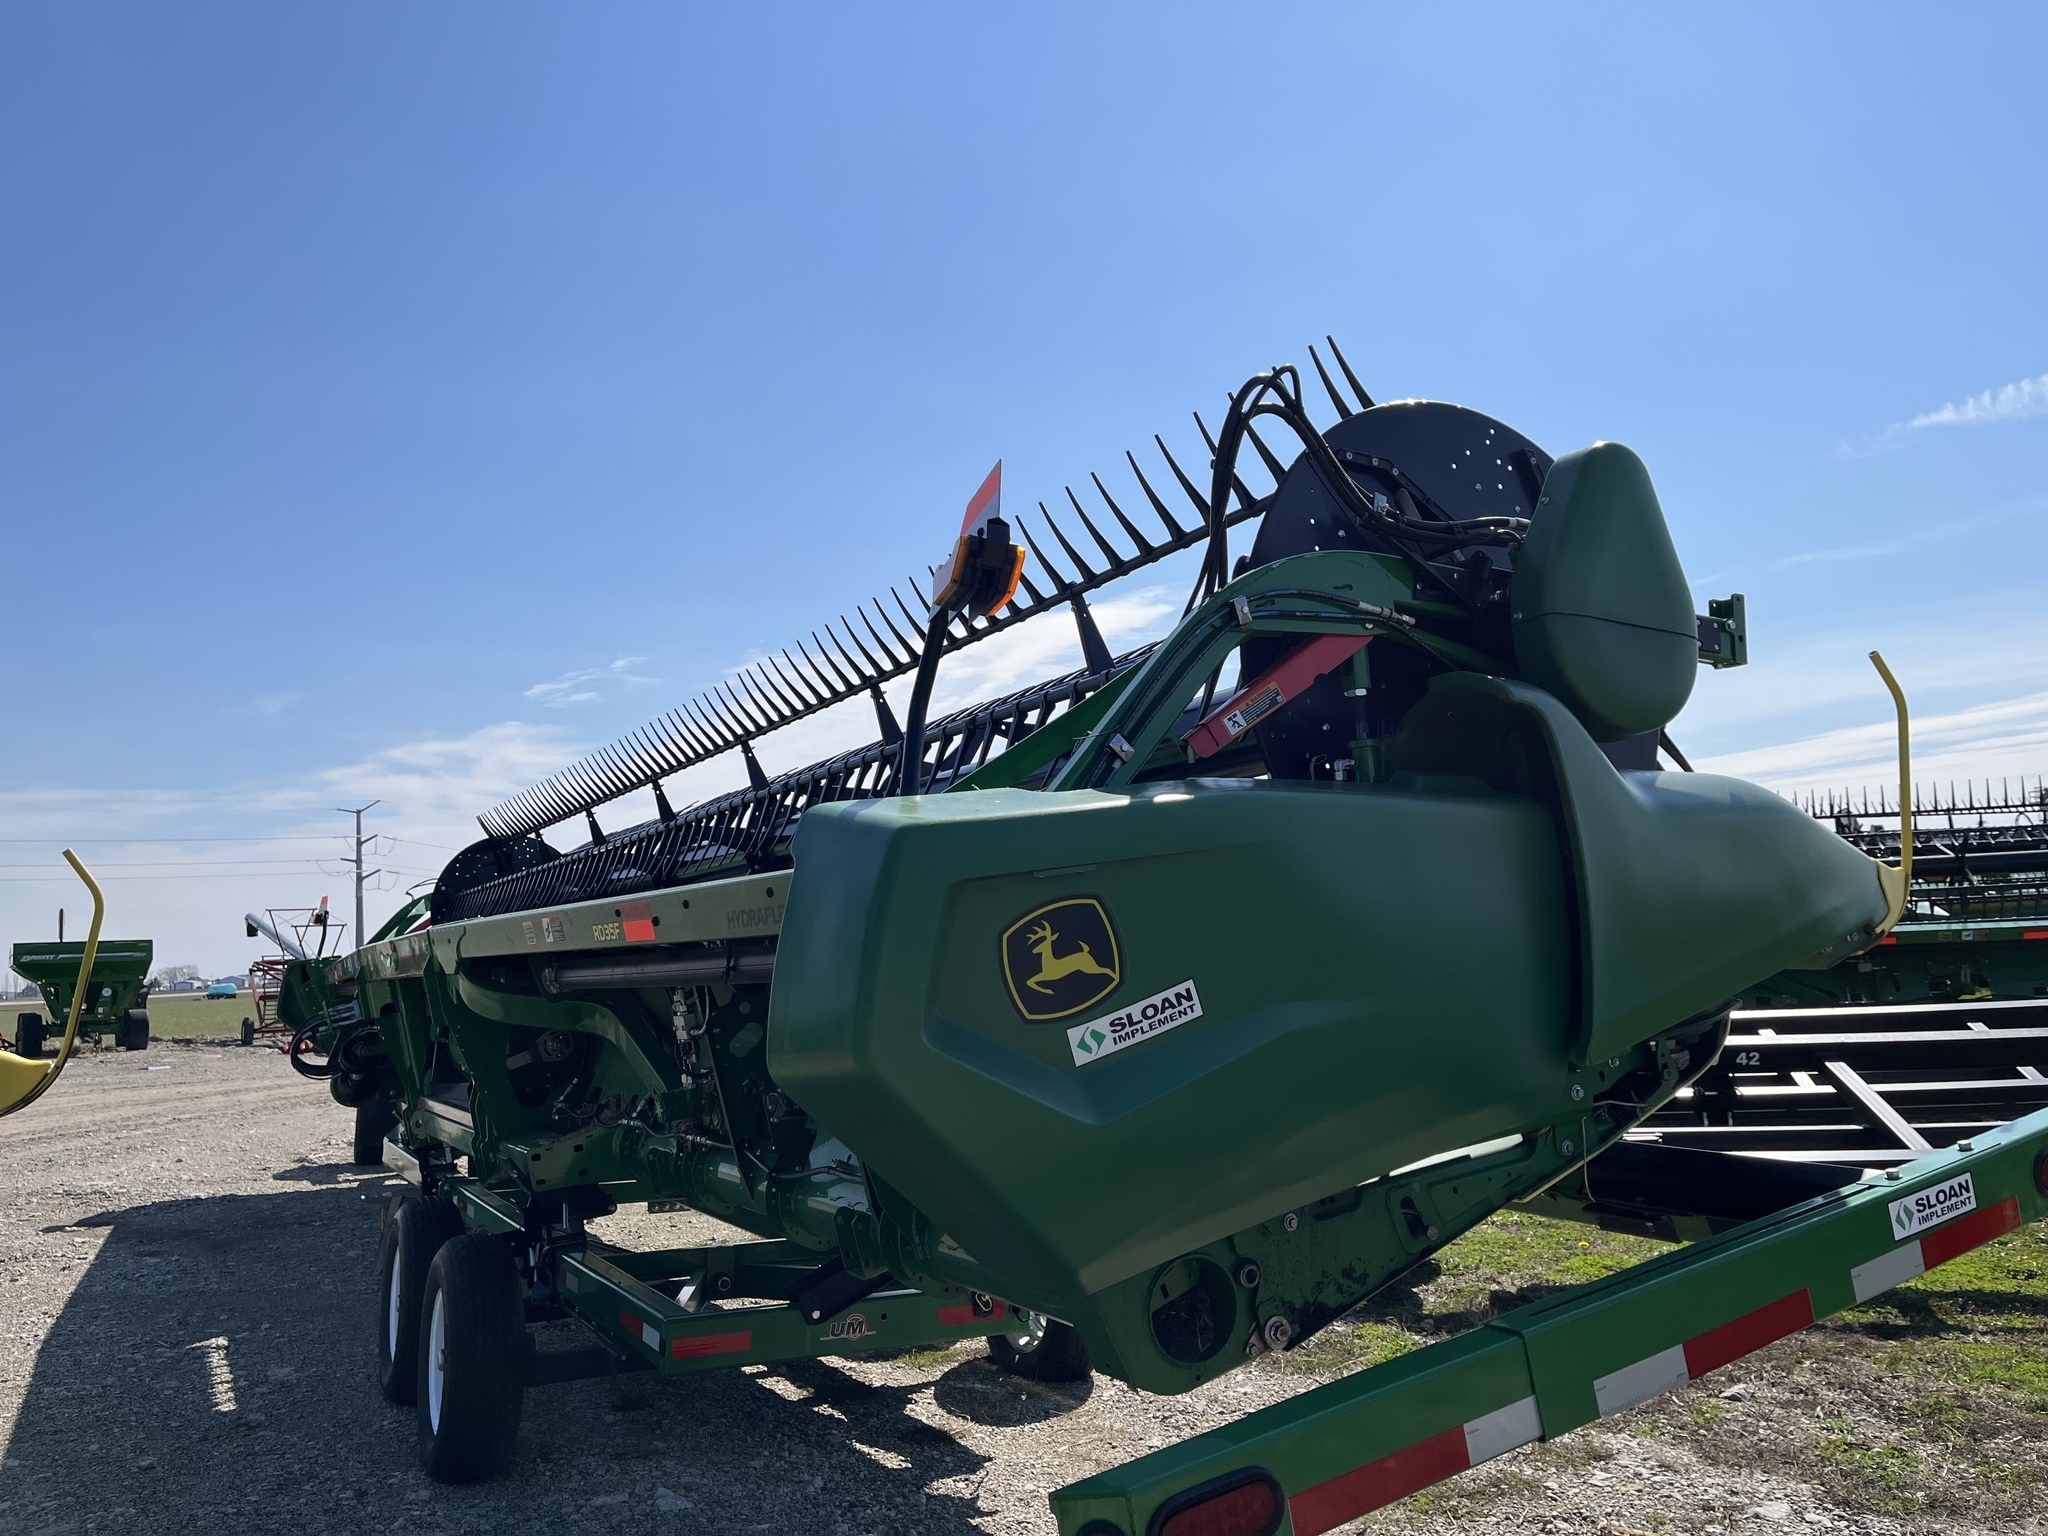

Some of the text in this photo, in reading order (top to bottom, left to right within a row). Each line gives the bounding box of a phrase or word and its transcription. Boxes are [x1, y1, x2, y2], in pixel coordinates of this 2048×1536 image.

[592, 922, 620, 941] RD35F
[1109, 987, 1195, 1034] SLOAN
[1113, 1003, 1196, 1046] IMPLEMENT
[1735, 1051, 1761, 1066] 42
[1915, 1179, 1971, 1214] SLOAN
[1917, 1195, 1973, 1226] IMPLEMENT
[829, 1315, 866, 1338] UM
